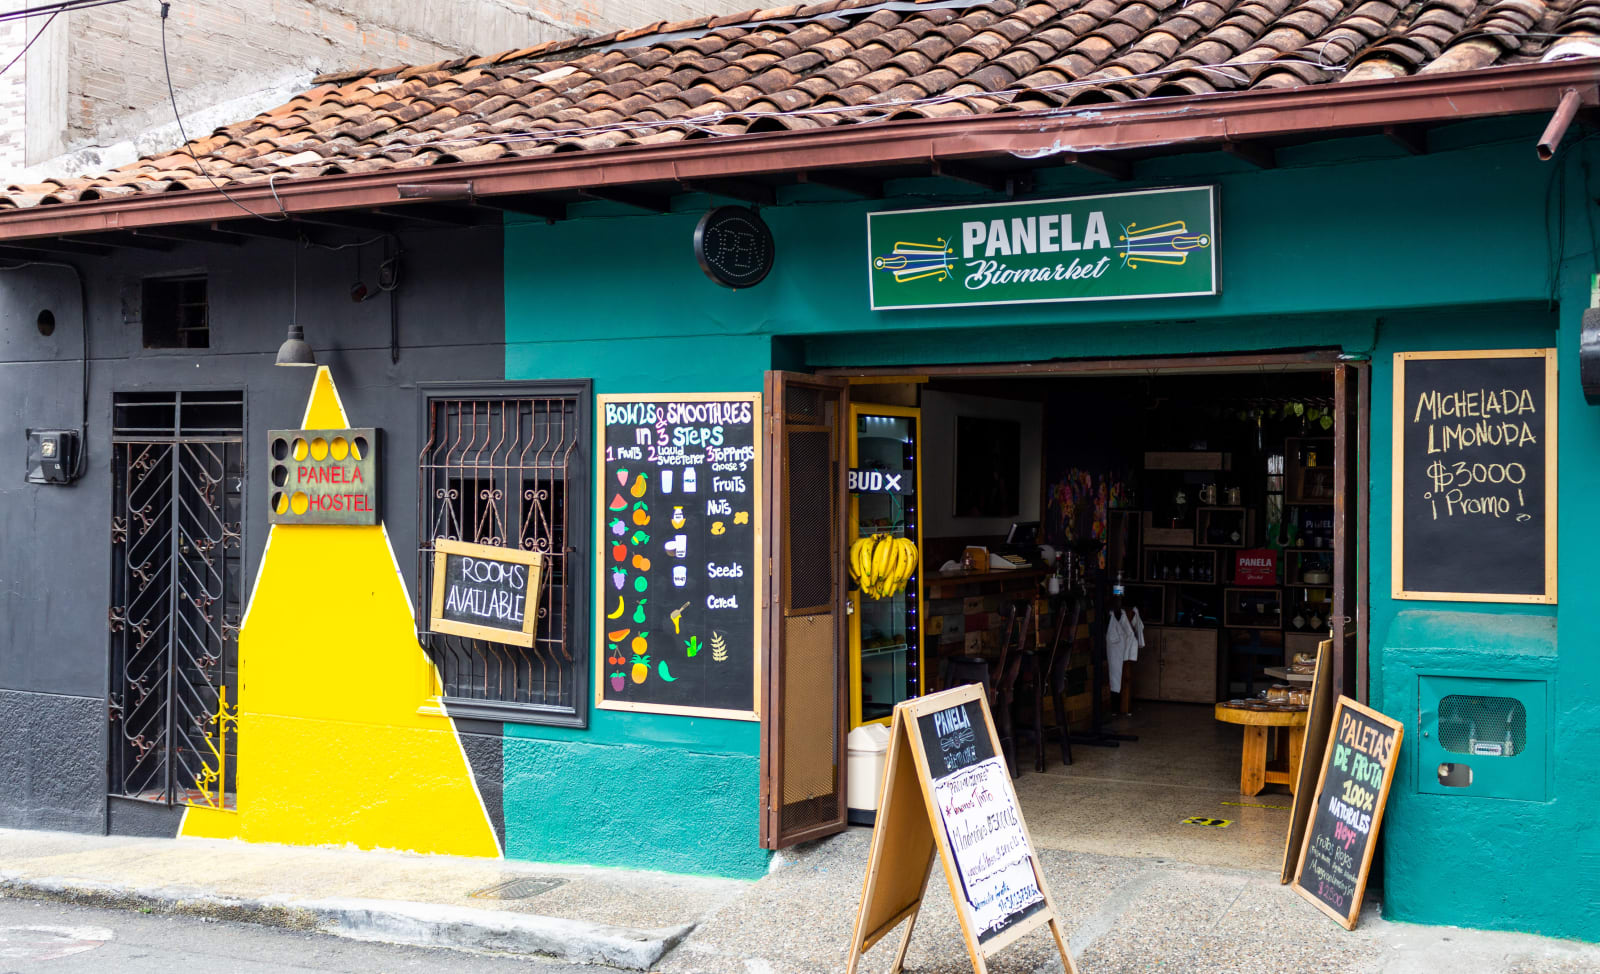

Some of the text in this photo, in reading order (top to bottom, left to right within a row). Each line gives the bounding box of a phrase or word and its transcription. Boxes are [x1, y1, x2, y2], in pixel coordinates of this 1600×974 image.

[962, 211, 1111, 258] PANELA
[965, 256, 1111, 290] Biomarket
[655, 407, 668, 429] &
[1414, 388, 1536, 423] MICHELADA
[656, 428, 669, 447] 3
[298, 466, 363, 484] PANELA
[738, 462, 748, 472] 3
[1426, 460, 1527, 493] $3000
[309, 494, 374, 512] HOSTEL
[462, 556, 524, 590] ROOMS
[707, 562, 744, 579] Seeds
[1239, 558, 1272, 567] PANELA
[446, 585, 525, 622] AVAILABLE
[933, 704, 971, 739] PANELA
[1339, 712, 1394, 768] PALETAS
[1334, 744, 1383, 790] DE FRUTA
[1342, 780, 1375, 811] 100%
